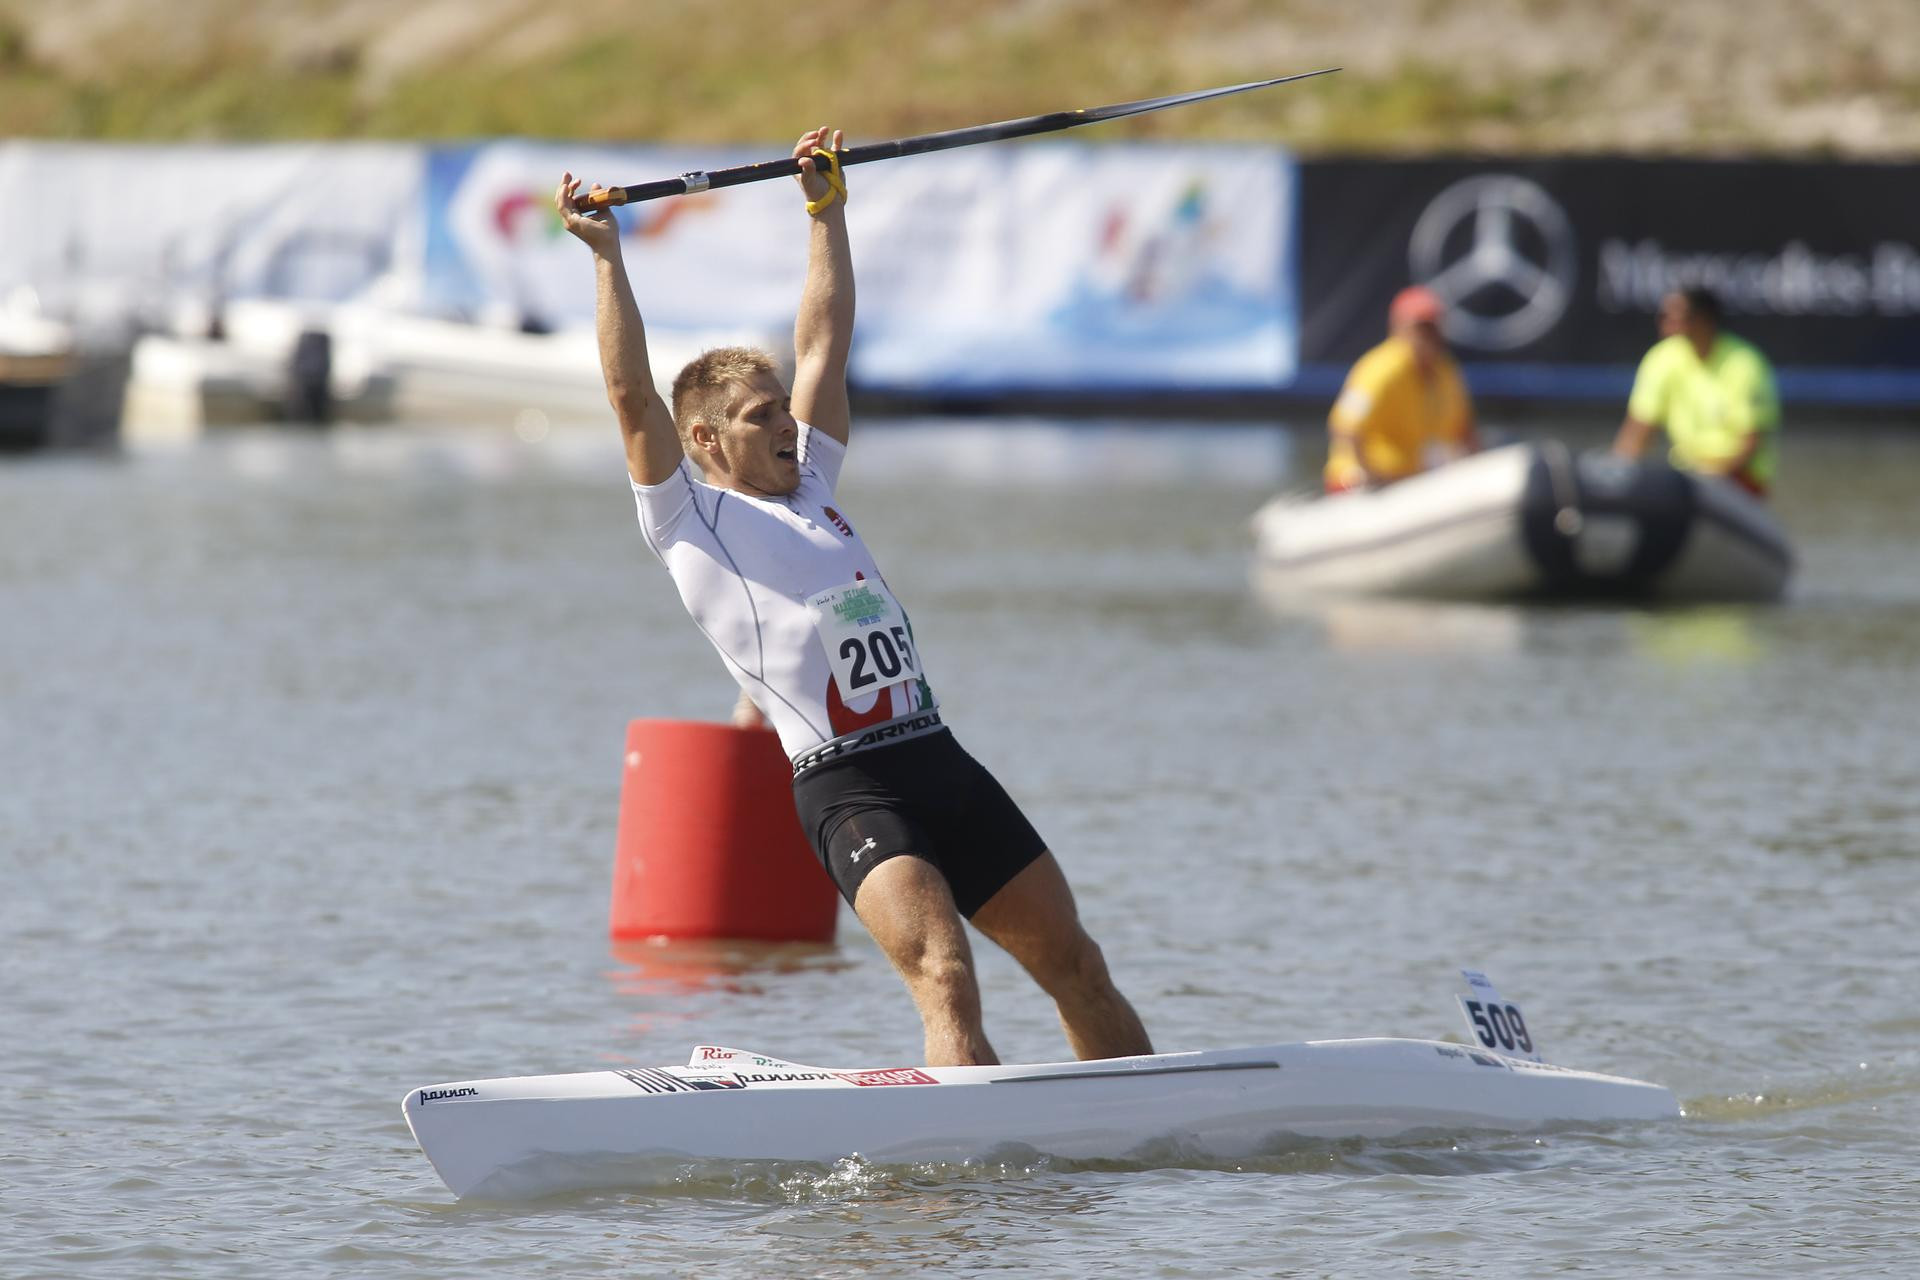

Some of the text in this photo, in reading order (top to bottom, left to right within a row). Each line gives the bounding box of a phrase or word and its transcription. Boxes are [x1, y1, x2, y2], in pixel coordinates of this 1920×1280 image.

[839, 626, 914, 690] 205
[1465, 1000, 1533, 1053] 509
[700, 1047, 738, 1061] Rio
[733, 1072, 838, 1089] pannon
[420, 1088, 479, 1106] pannon
